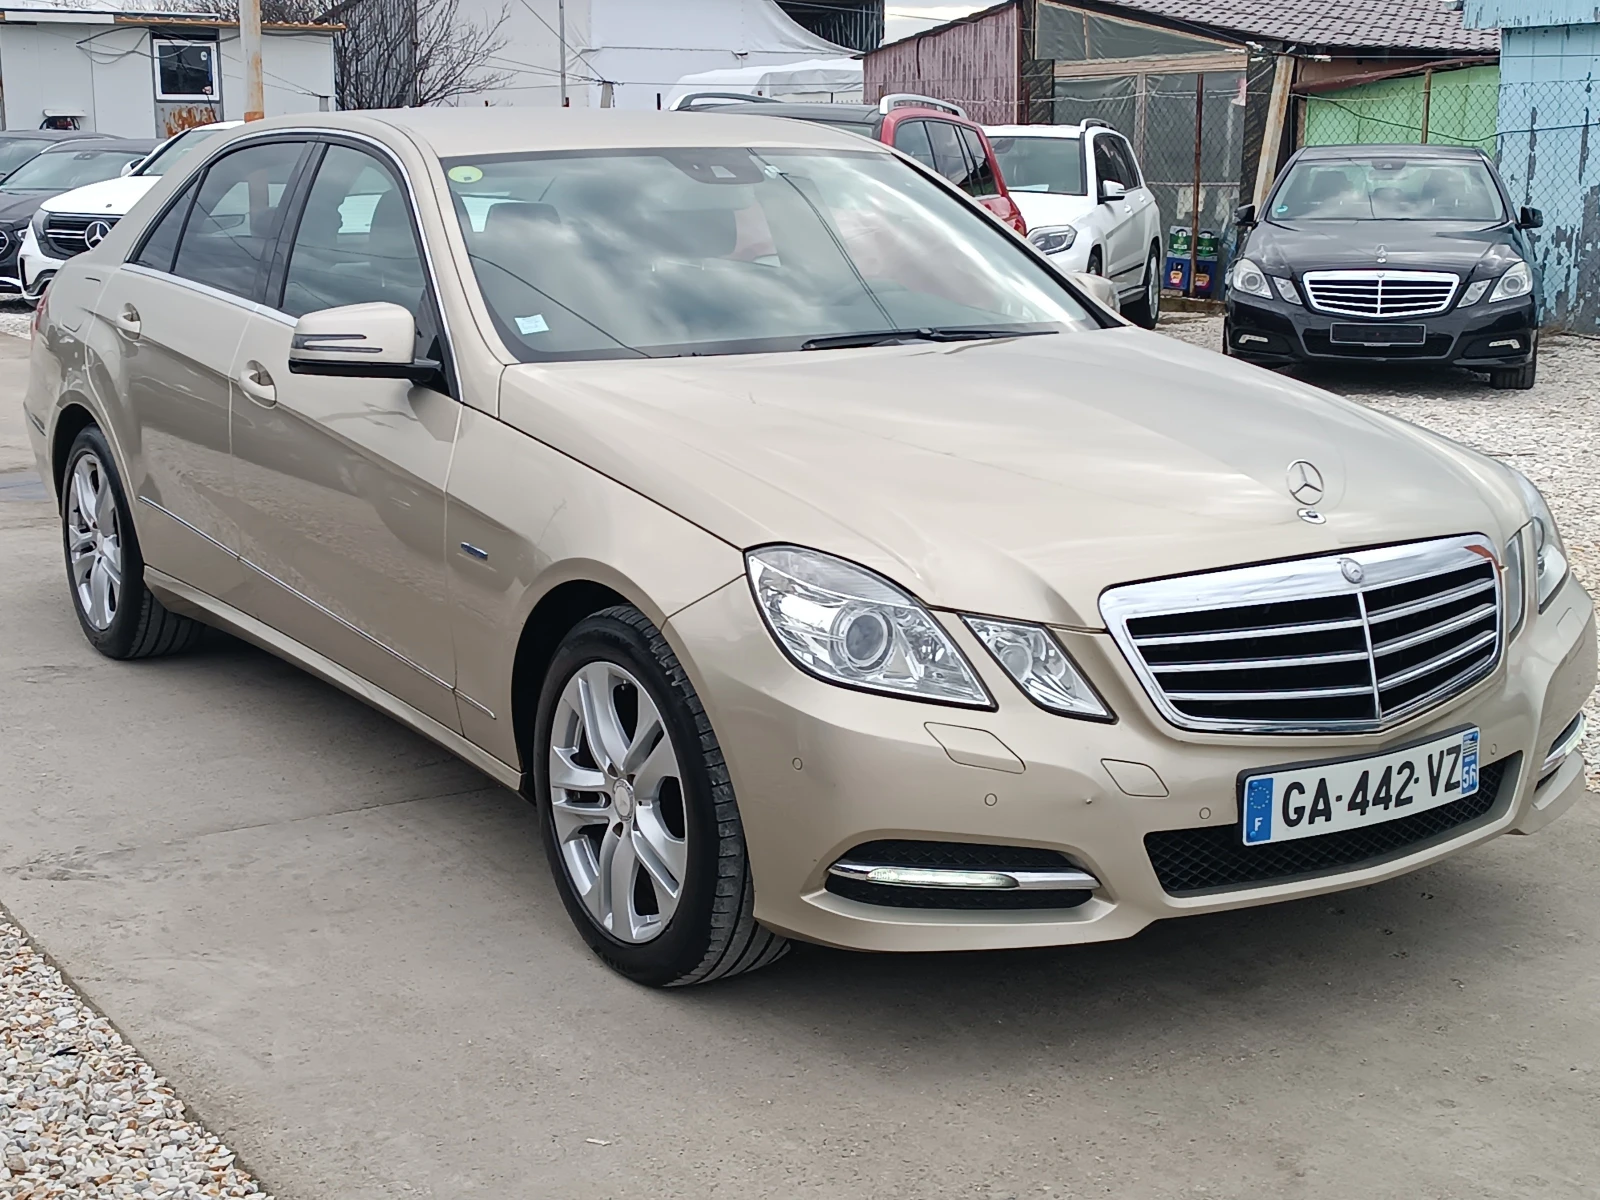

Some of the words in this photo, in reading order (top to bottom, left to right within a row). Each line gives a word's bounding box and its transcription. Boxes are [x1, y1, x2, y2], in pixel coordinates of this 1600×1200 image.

[1282, 744, 1461, 827] GA-442-VZ
[1462, 763, 1477, 789] 56
[1254, 817, 1263, 832] F
